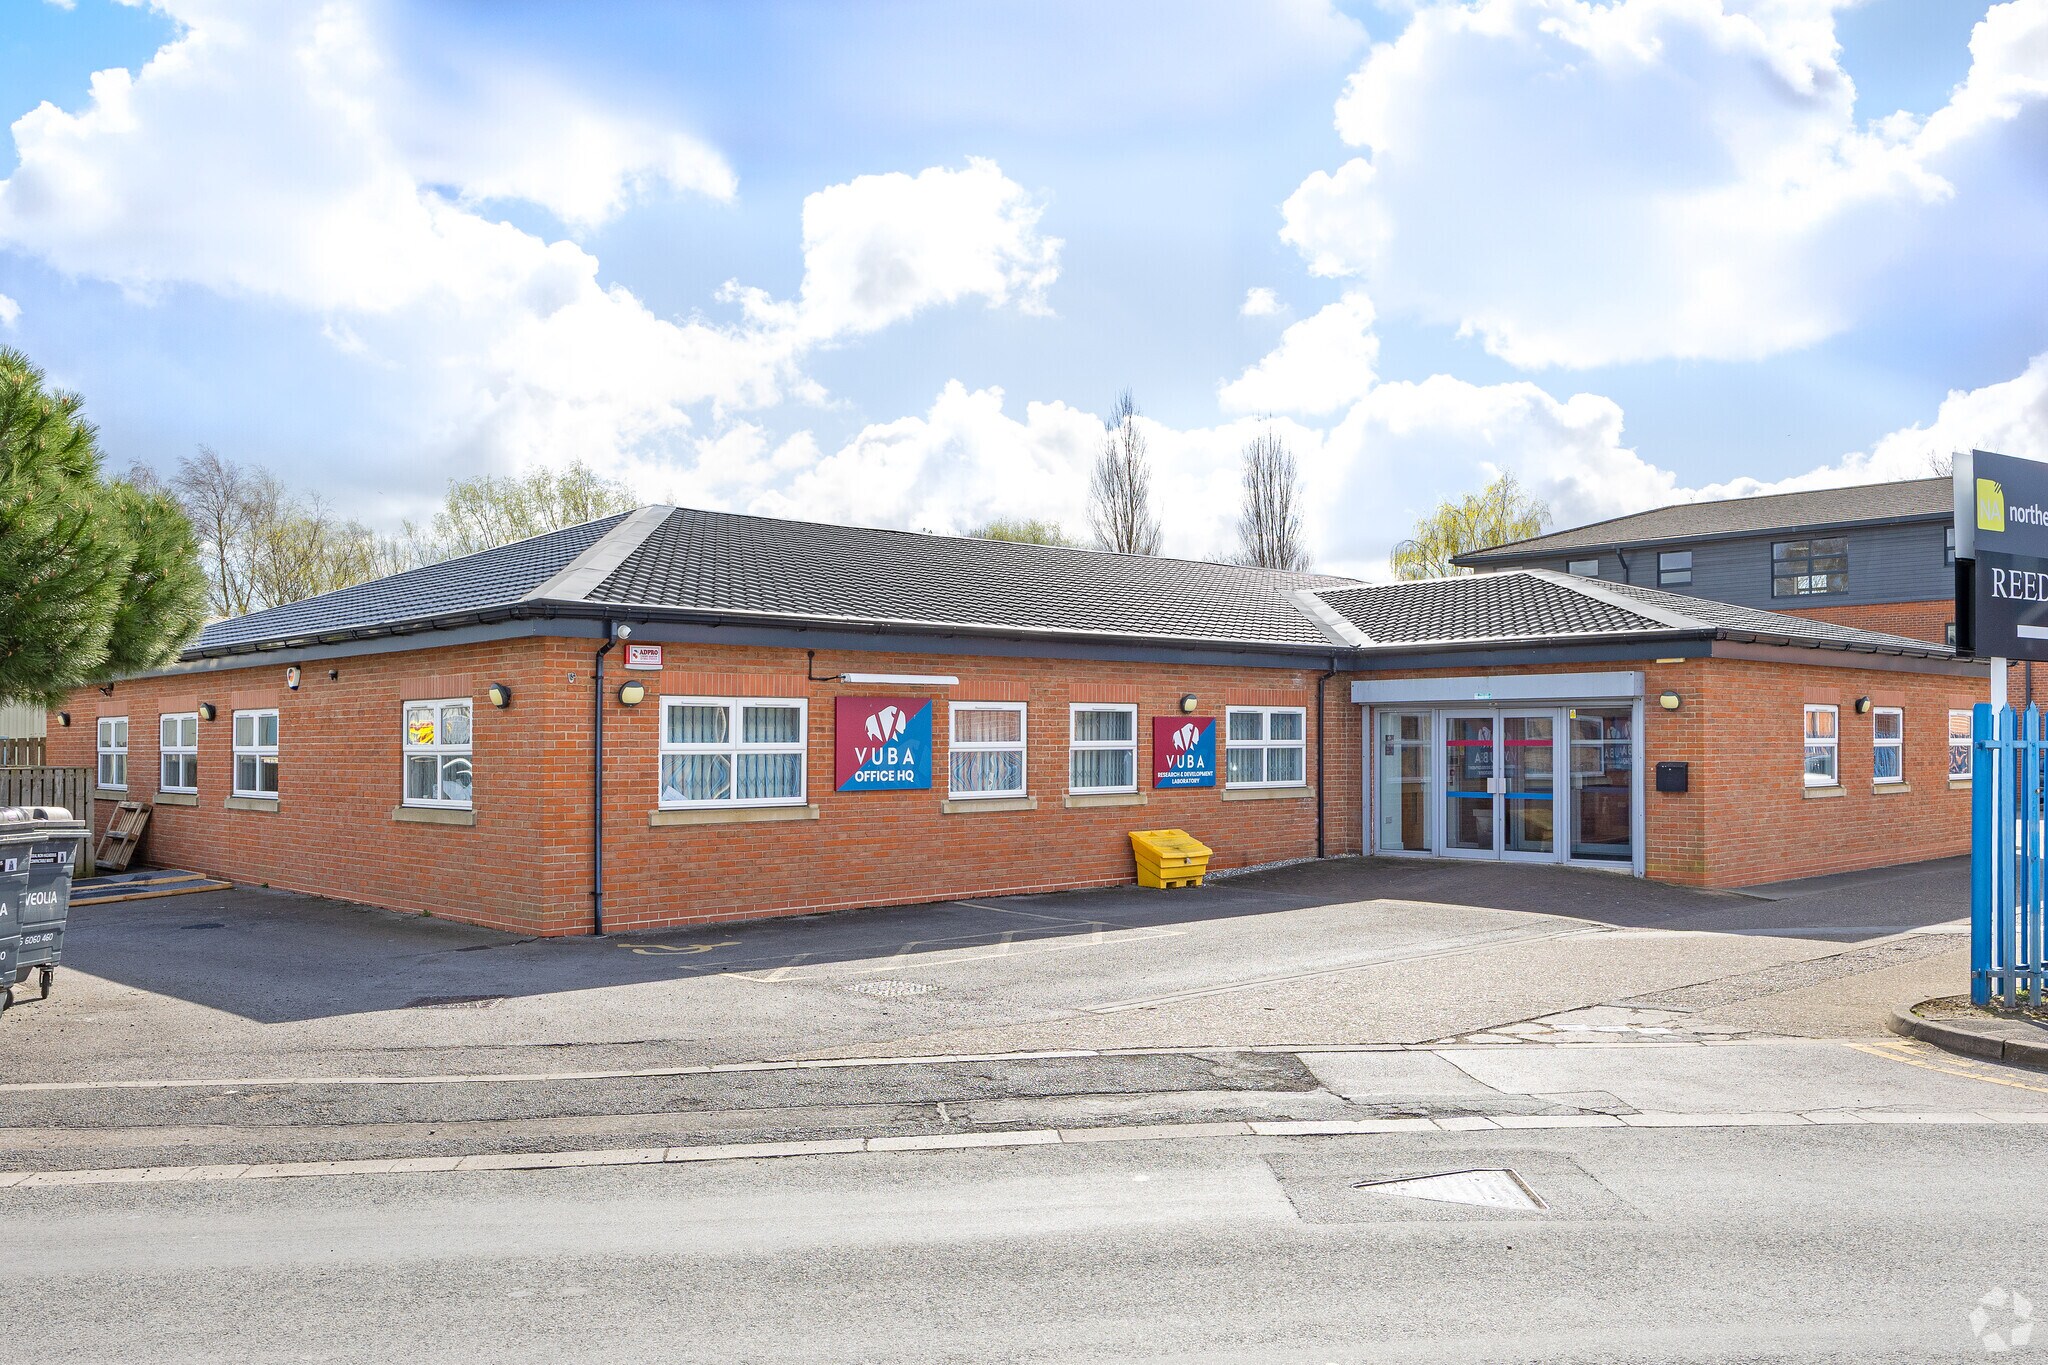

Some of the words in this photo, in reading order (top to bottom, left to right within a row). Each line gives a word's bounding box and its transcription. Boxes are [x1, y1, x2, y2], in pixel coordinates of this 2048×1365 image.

[1980, 499, 2001, 521] NA
[854, 747, 915, 765] VUBA
[1166, 754, 1204, 768] VUBA
[854, 770, 895, 782] OFFICE
[897, 769, 915, 782] HQ
[25, 891, 57, 906] VEOLIA
[24, 934, 41, 945] 6060
